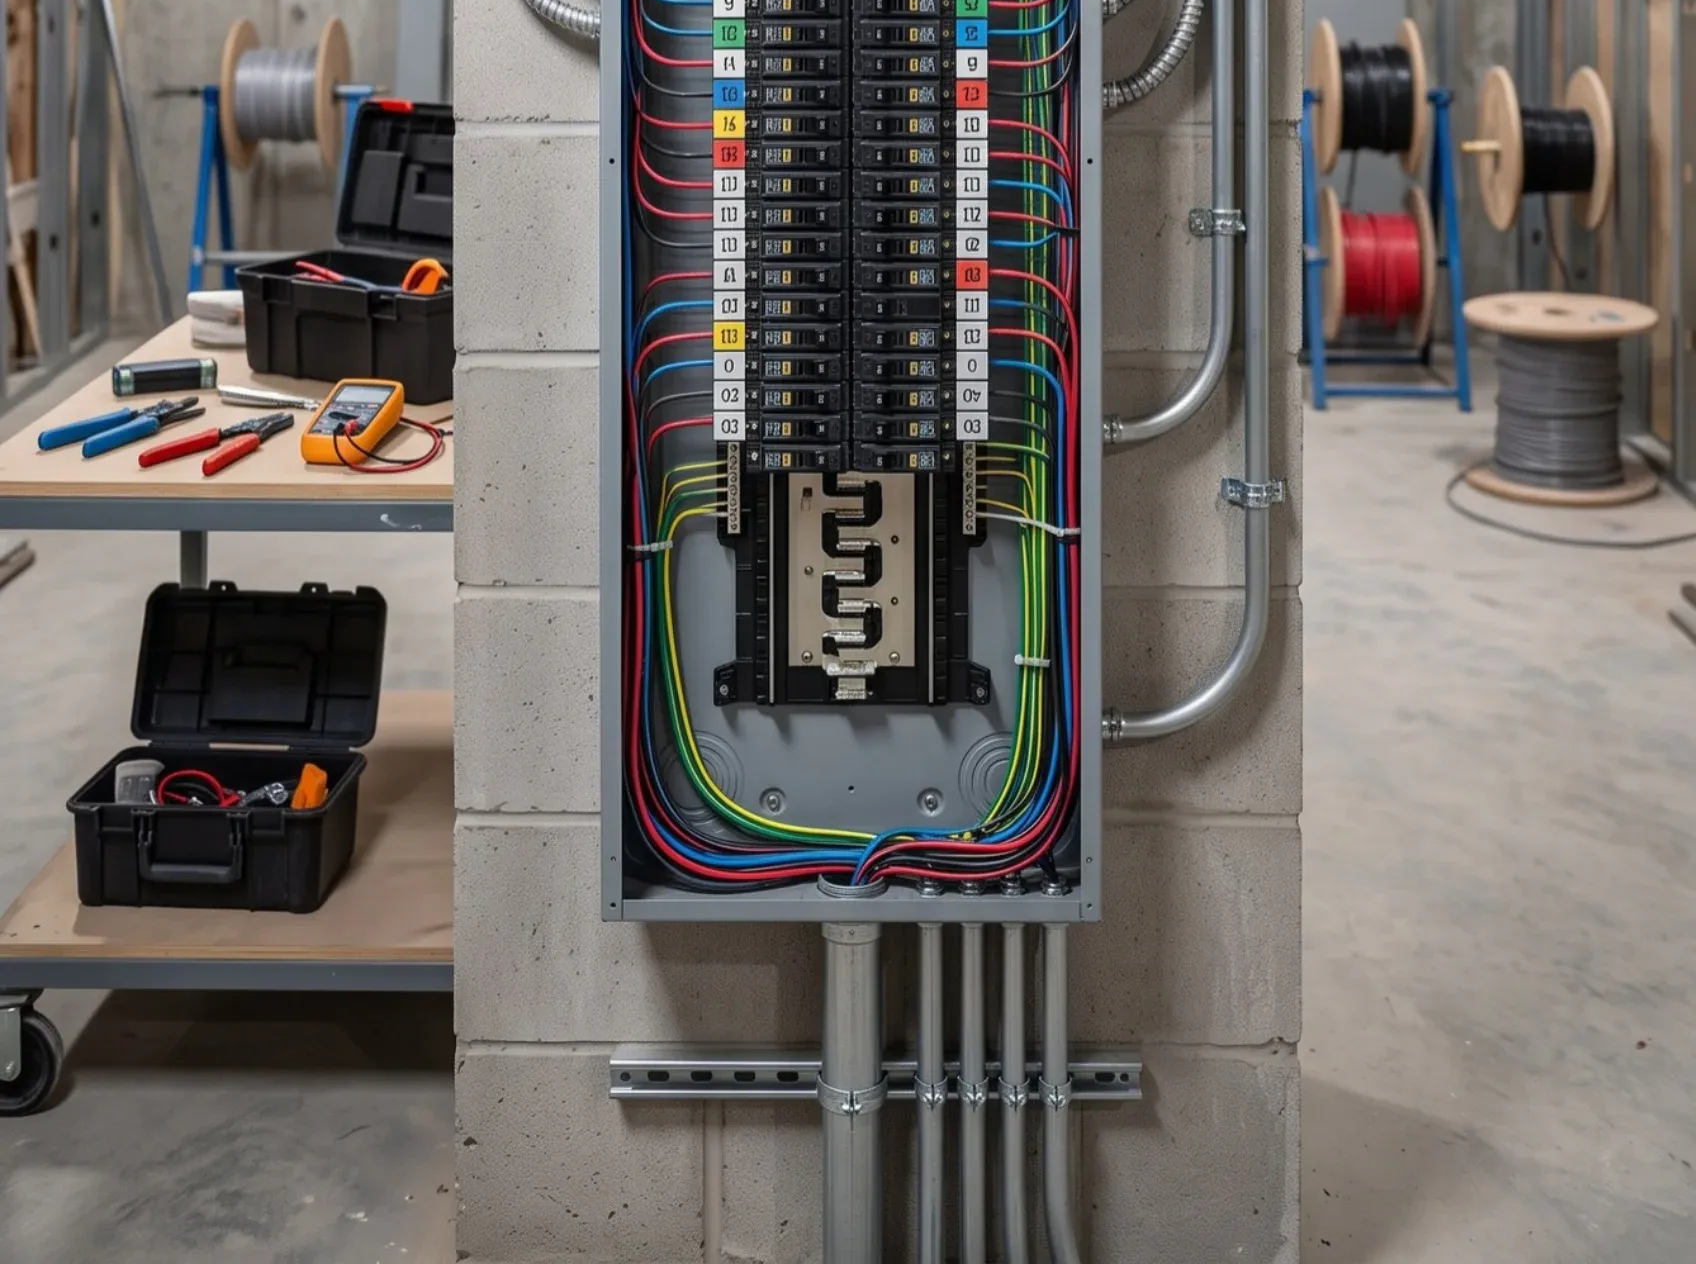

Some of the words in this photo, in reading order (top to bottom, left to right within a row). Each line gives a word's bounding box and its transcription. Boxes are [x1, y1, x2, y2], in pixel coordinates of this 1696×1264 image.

[967, 56, 978, 72] 9
[724, 358, 735, 373] 0
[967, 358, 978, 373] 0
[721, 418, 739, 434] 03
[963, 418, 982, 434] 03
